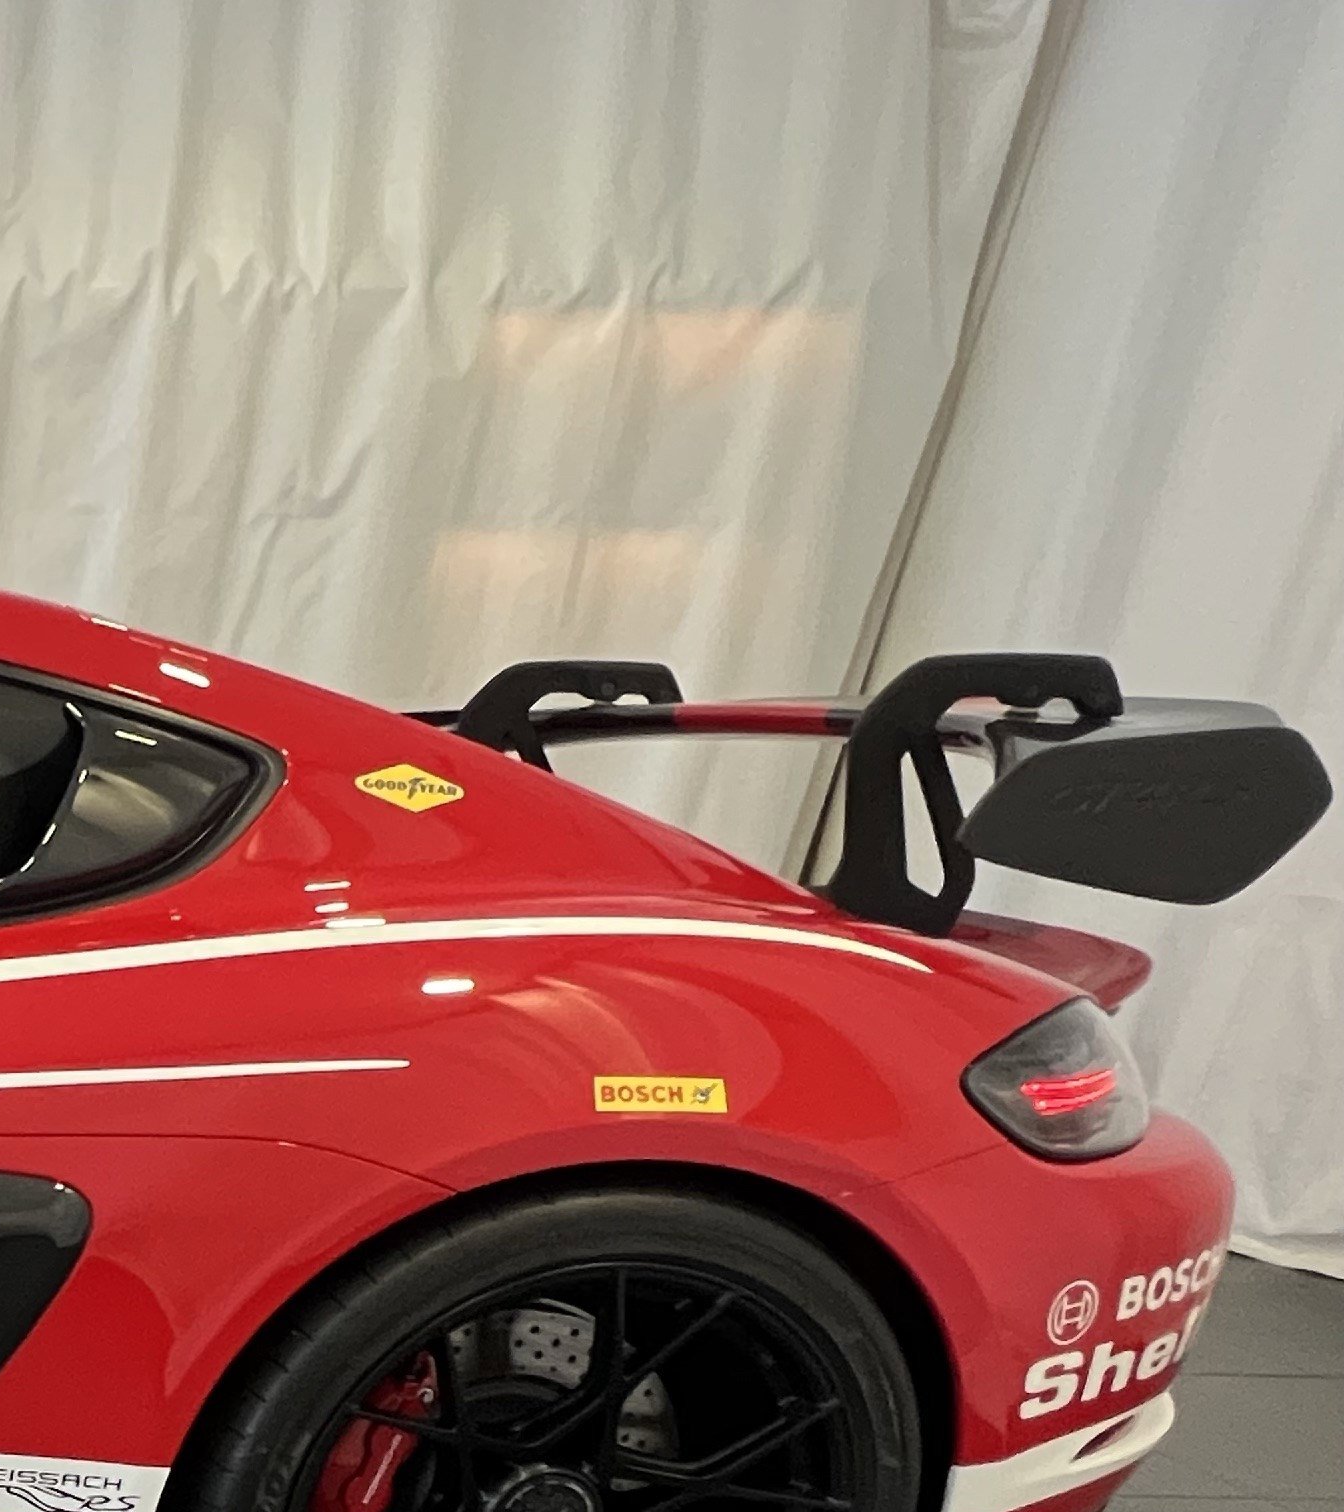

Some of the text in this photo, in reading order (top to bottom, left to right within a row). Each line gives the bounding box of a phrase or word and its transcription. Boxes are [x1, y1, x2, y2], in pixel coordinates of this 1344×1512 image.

[600, 1085, 684, 1104] BOSCH
[1116, 1243, 1227, 1321] BOSC
[1019, 1305, 1202, 1420] Shel
[79, 1495, 142, 1512] RS
